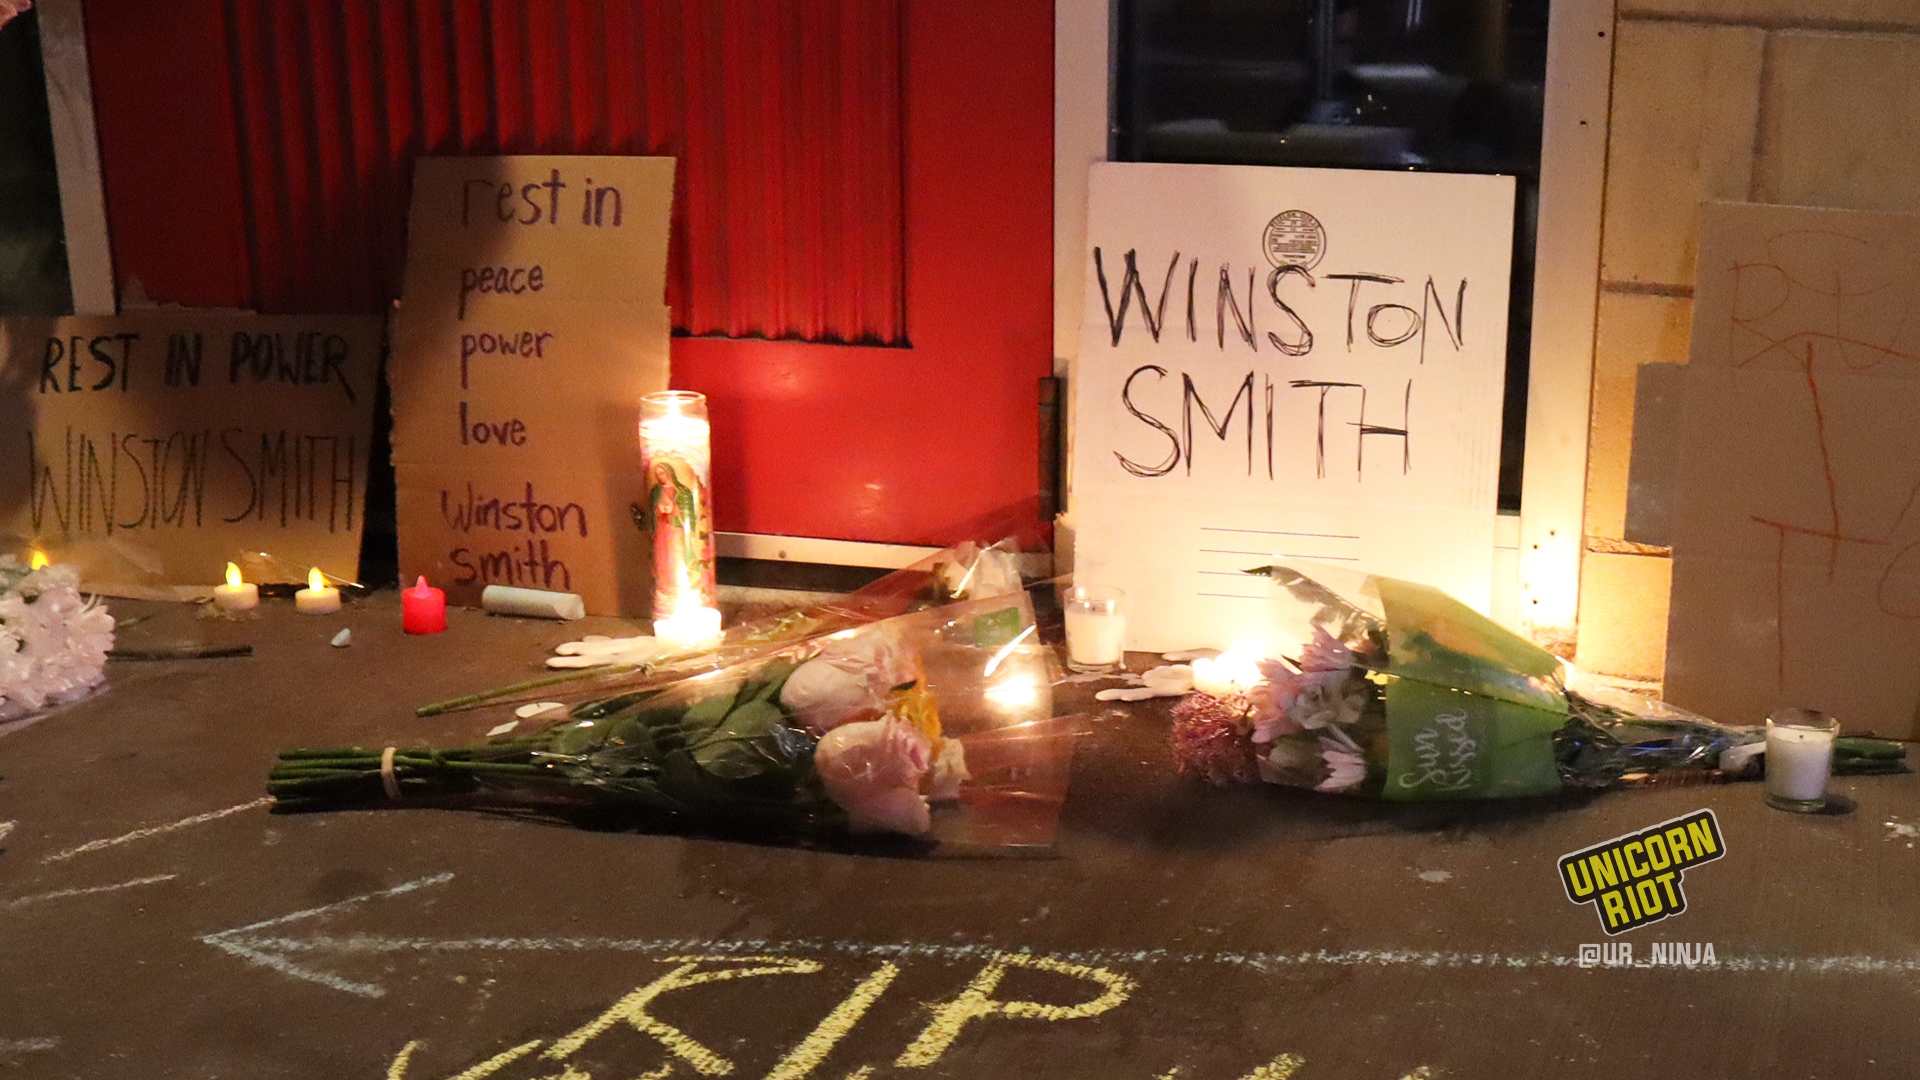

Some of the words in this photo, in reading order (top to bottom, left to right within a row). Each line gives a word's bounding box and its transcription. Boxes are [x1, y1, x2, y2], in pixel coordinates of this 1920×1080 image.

[462, 168, 566, 226] rest
[582, 177, 623, 228] in
[457, 264, 544, 321] peace
[39, 333, 140, 394] REST
[163, 333, 204, 388] IN
[229, 331, 356, 401] POWER
[460, 331, 553, 390] power
[460, 401, 527, 445] love
[1113, 364, 1412, 483] SMITH
[27, 425, 210, 537] WINSTON
[220, 427, 356, 534] SMITH
[441, 481, 588, 538] Winston
[1400, 728, 1447, 788] Sun
[537, 949, 1140, 1080] RIP
